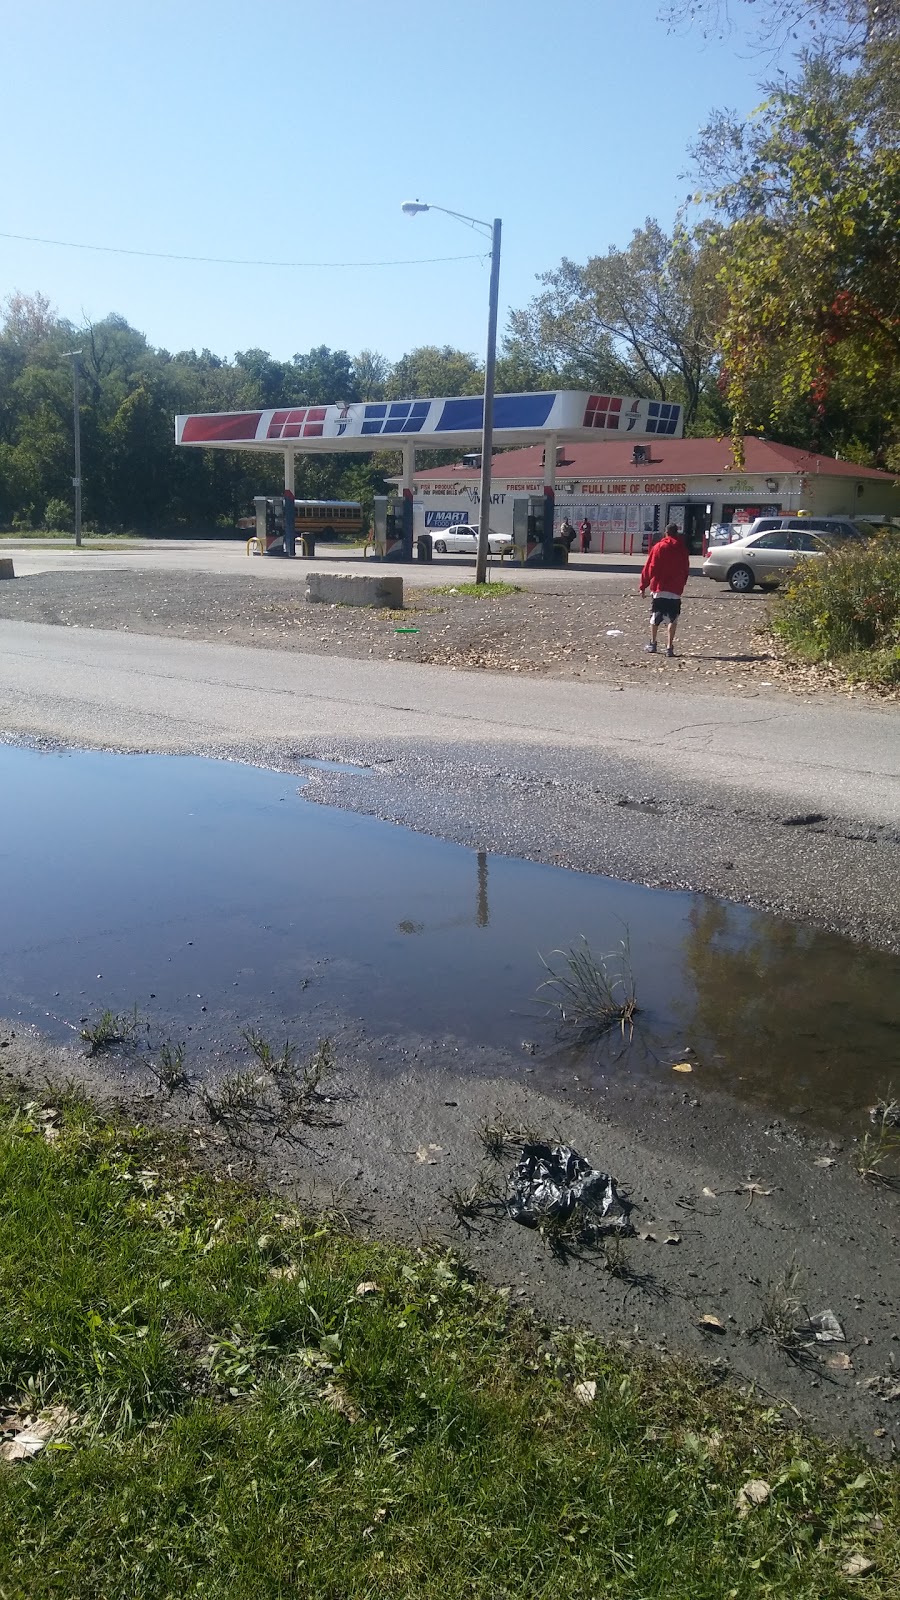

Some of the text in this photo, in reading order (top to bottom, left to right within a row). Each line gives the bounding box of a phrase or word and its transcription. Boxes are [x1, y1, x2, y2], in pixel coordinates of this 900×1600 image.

[581, 483, 687, 494] FULL LINE OF GROCERIES
[427, 512, 468, 526] V MART
